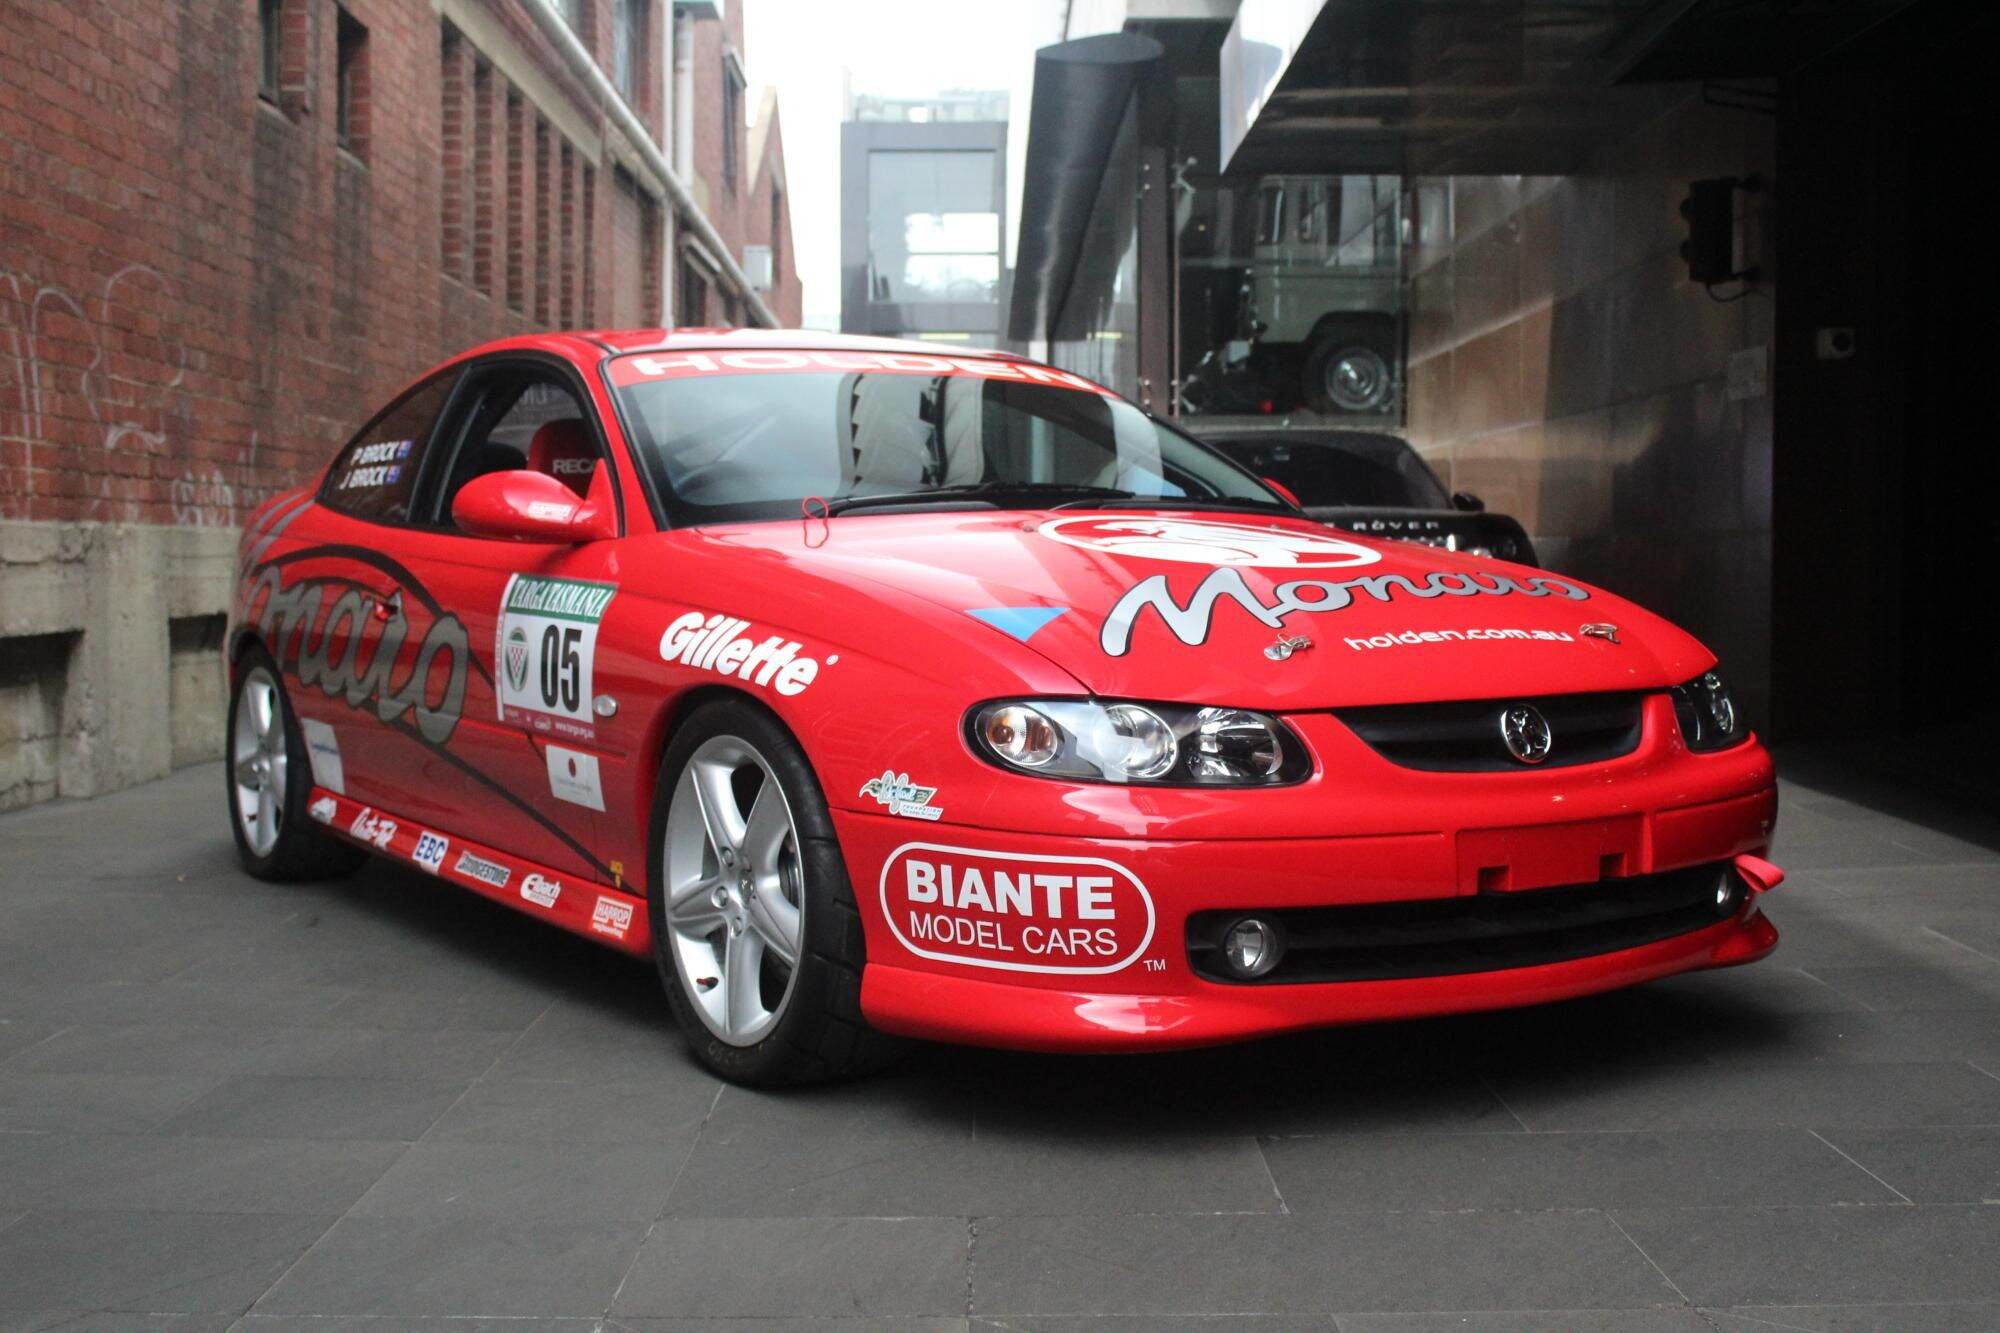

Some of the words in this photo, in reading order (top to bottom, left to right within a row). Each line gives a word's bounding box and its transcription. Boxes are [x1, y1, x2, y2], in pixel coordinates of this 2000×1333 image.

[631, 350, 1096, 389] HOLDEN
[510, 579, 549, 612] TARGA
[1100, 567, 1591, 657] Monaro
[659, 611, 819, 696] Gillette
[1344, 628, 1575, 651] holden.com.au
[541, 624, 583, 713] 05
[416, 835, 446, 864] EBC
[905, 859, 1116, 920] BIANTE
[909, 911, 1014, 952] MODEL
[1021, 926, 1118, 956] CARS
[1143, 959, 1166, 972] TM
